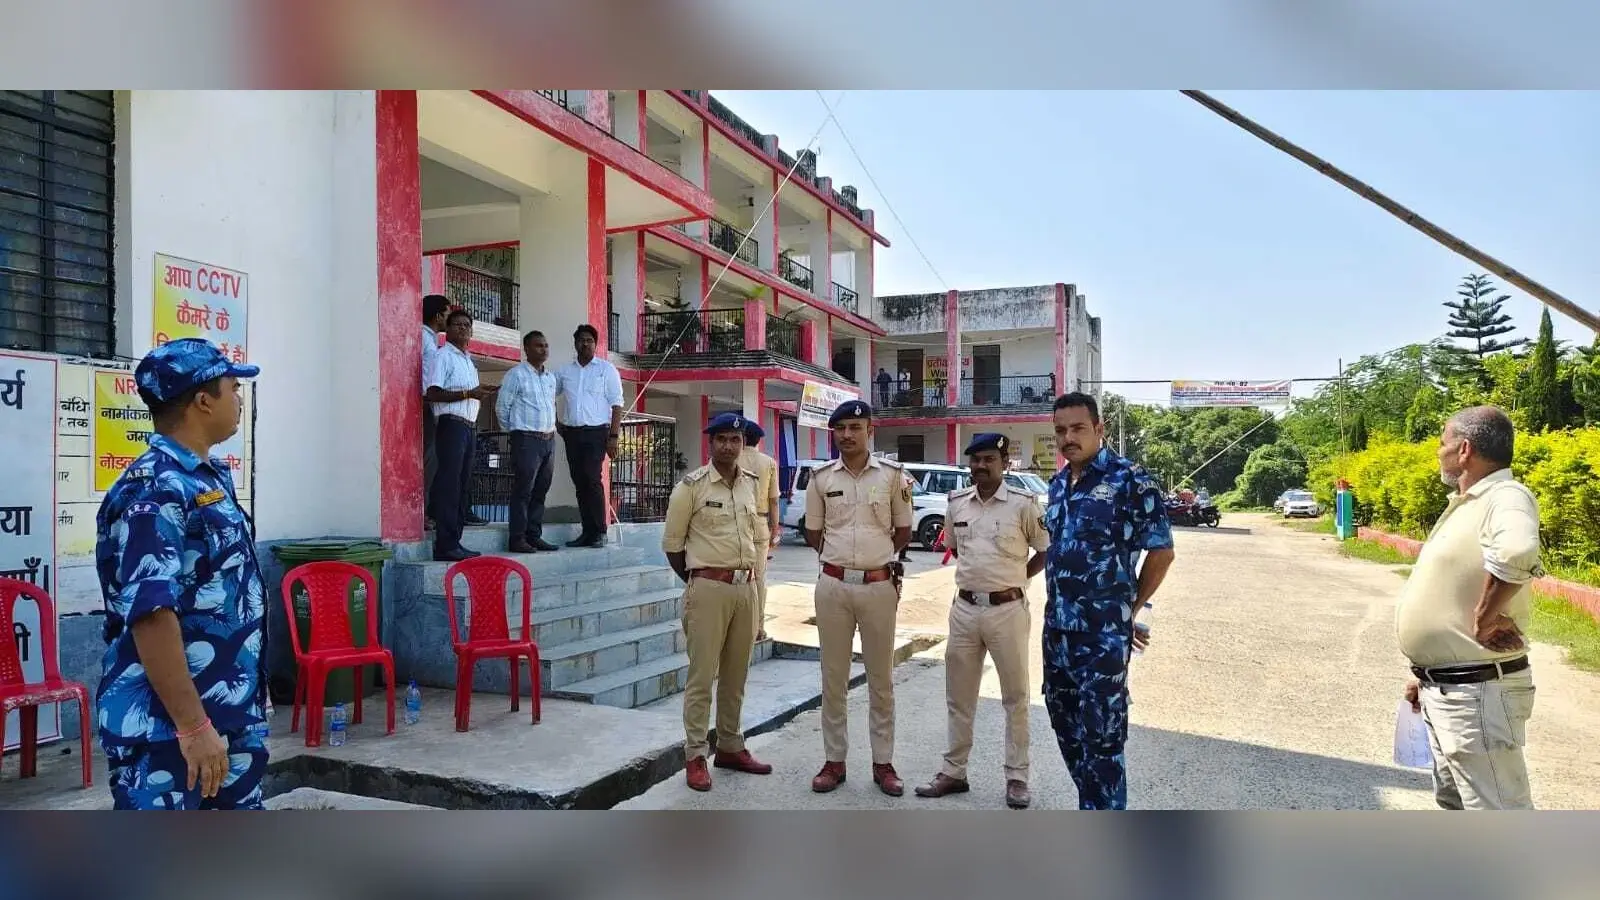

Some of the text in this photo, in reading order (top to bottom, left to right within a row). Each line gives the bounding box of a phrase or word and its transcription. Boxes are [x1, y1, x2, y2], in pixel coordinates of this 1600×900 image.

[164, 265, 240, 298] आप CCTV
[176, 298, 229, 331] कैमरे के
[930, 369, 966, 378] Waig
[115, 378, 138, 394] NR
